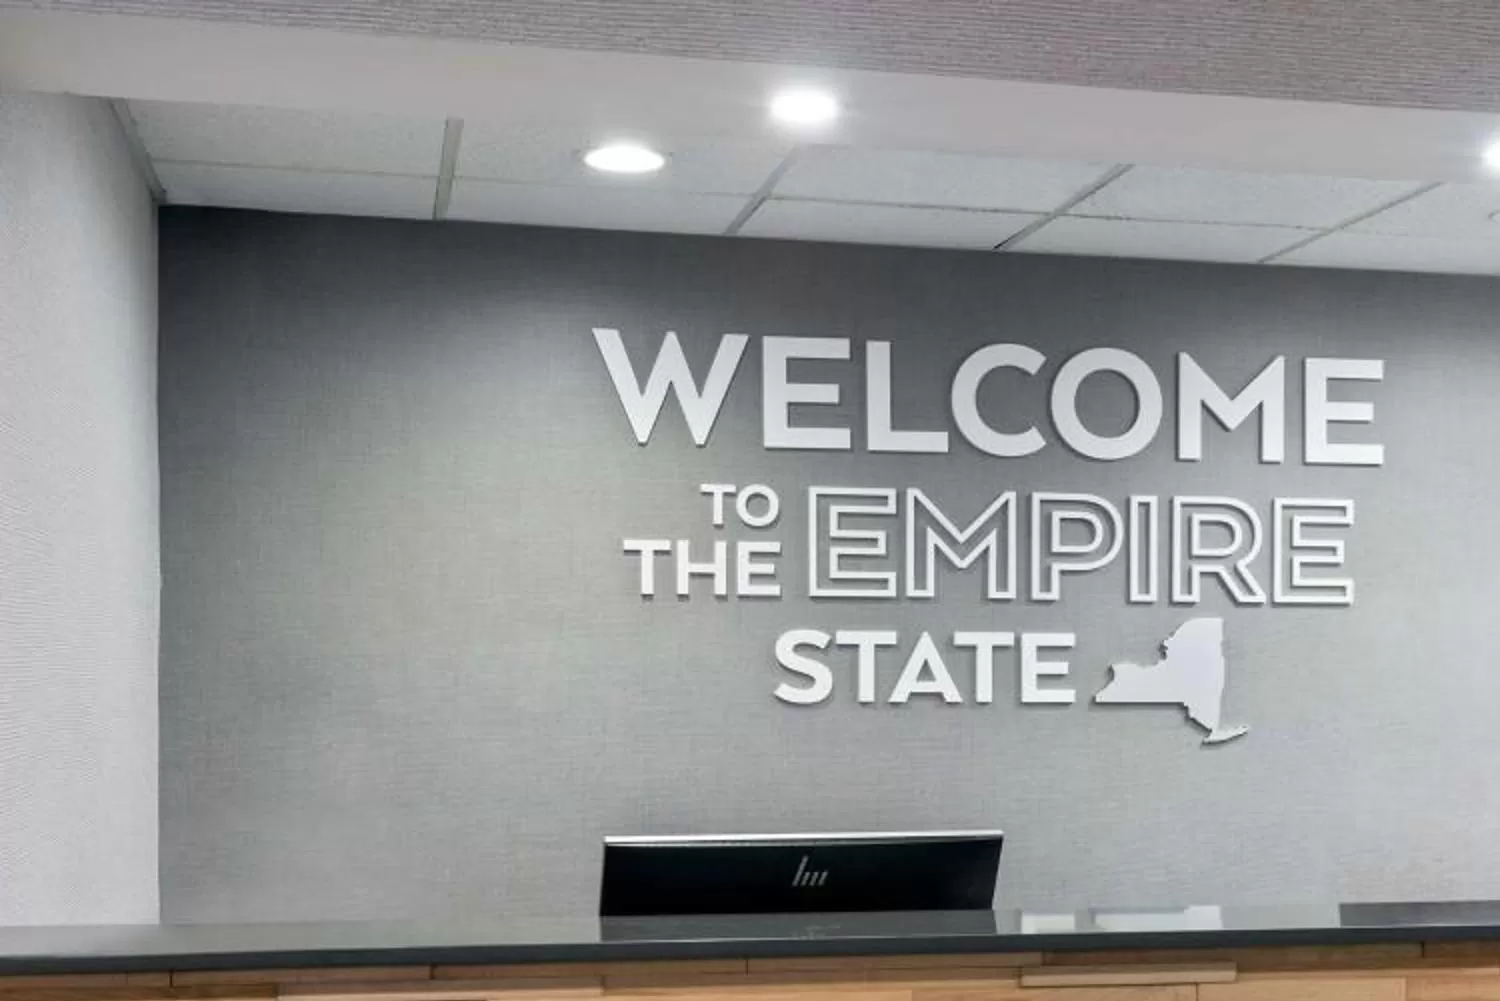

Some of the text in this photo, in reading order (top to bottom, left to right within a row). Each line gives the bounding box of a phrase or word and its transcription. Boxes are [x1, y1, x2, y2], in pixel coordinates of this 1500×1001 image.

[592, 328, 1385, 464] WELCOME
[623, 486, 1355, 604] THE EMPIRE
[700, 483, 780, 527] TO
[773, 629, 1076, 704] STATE
